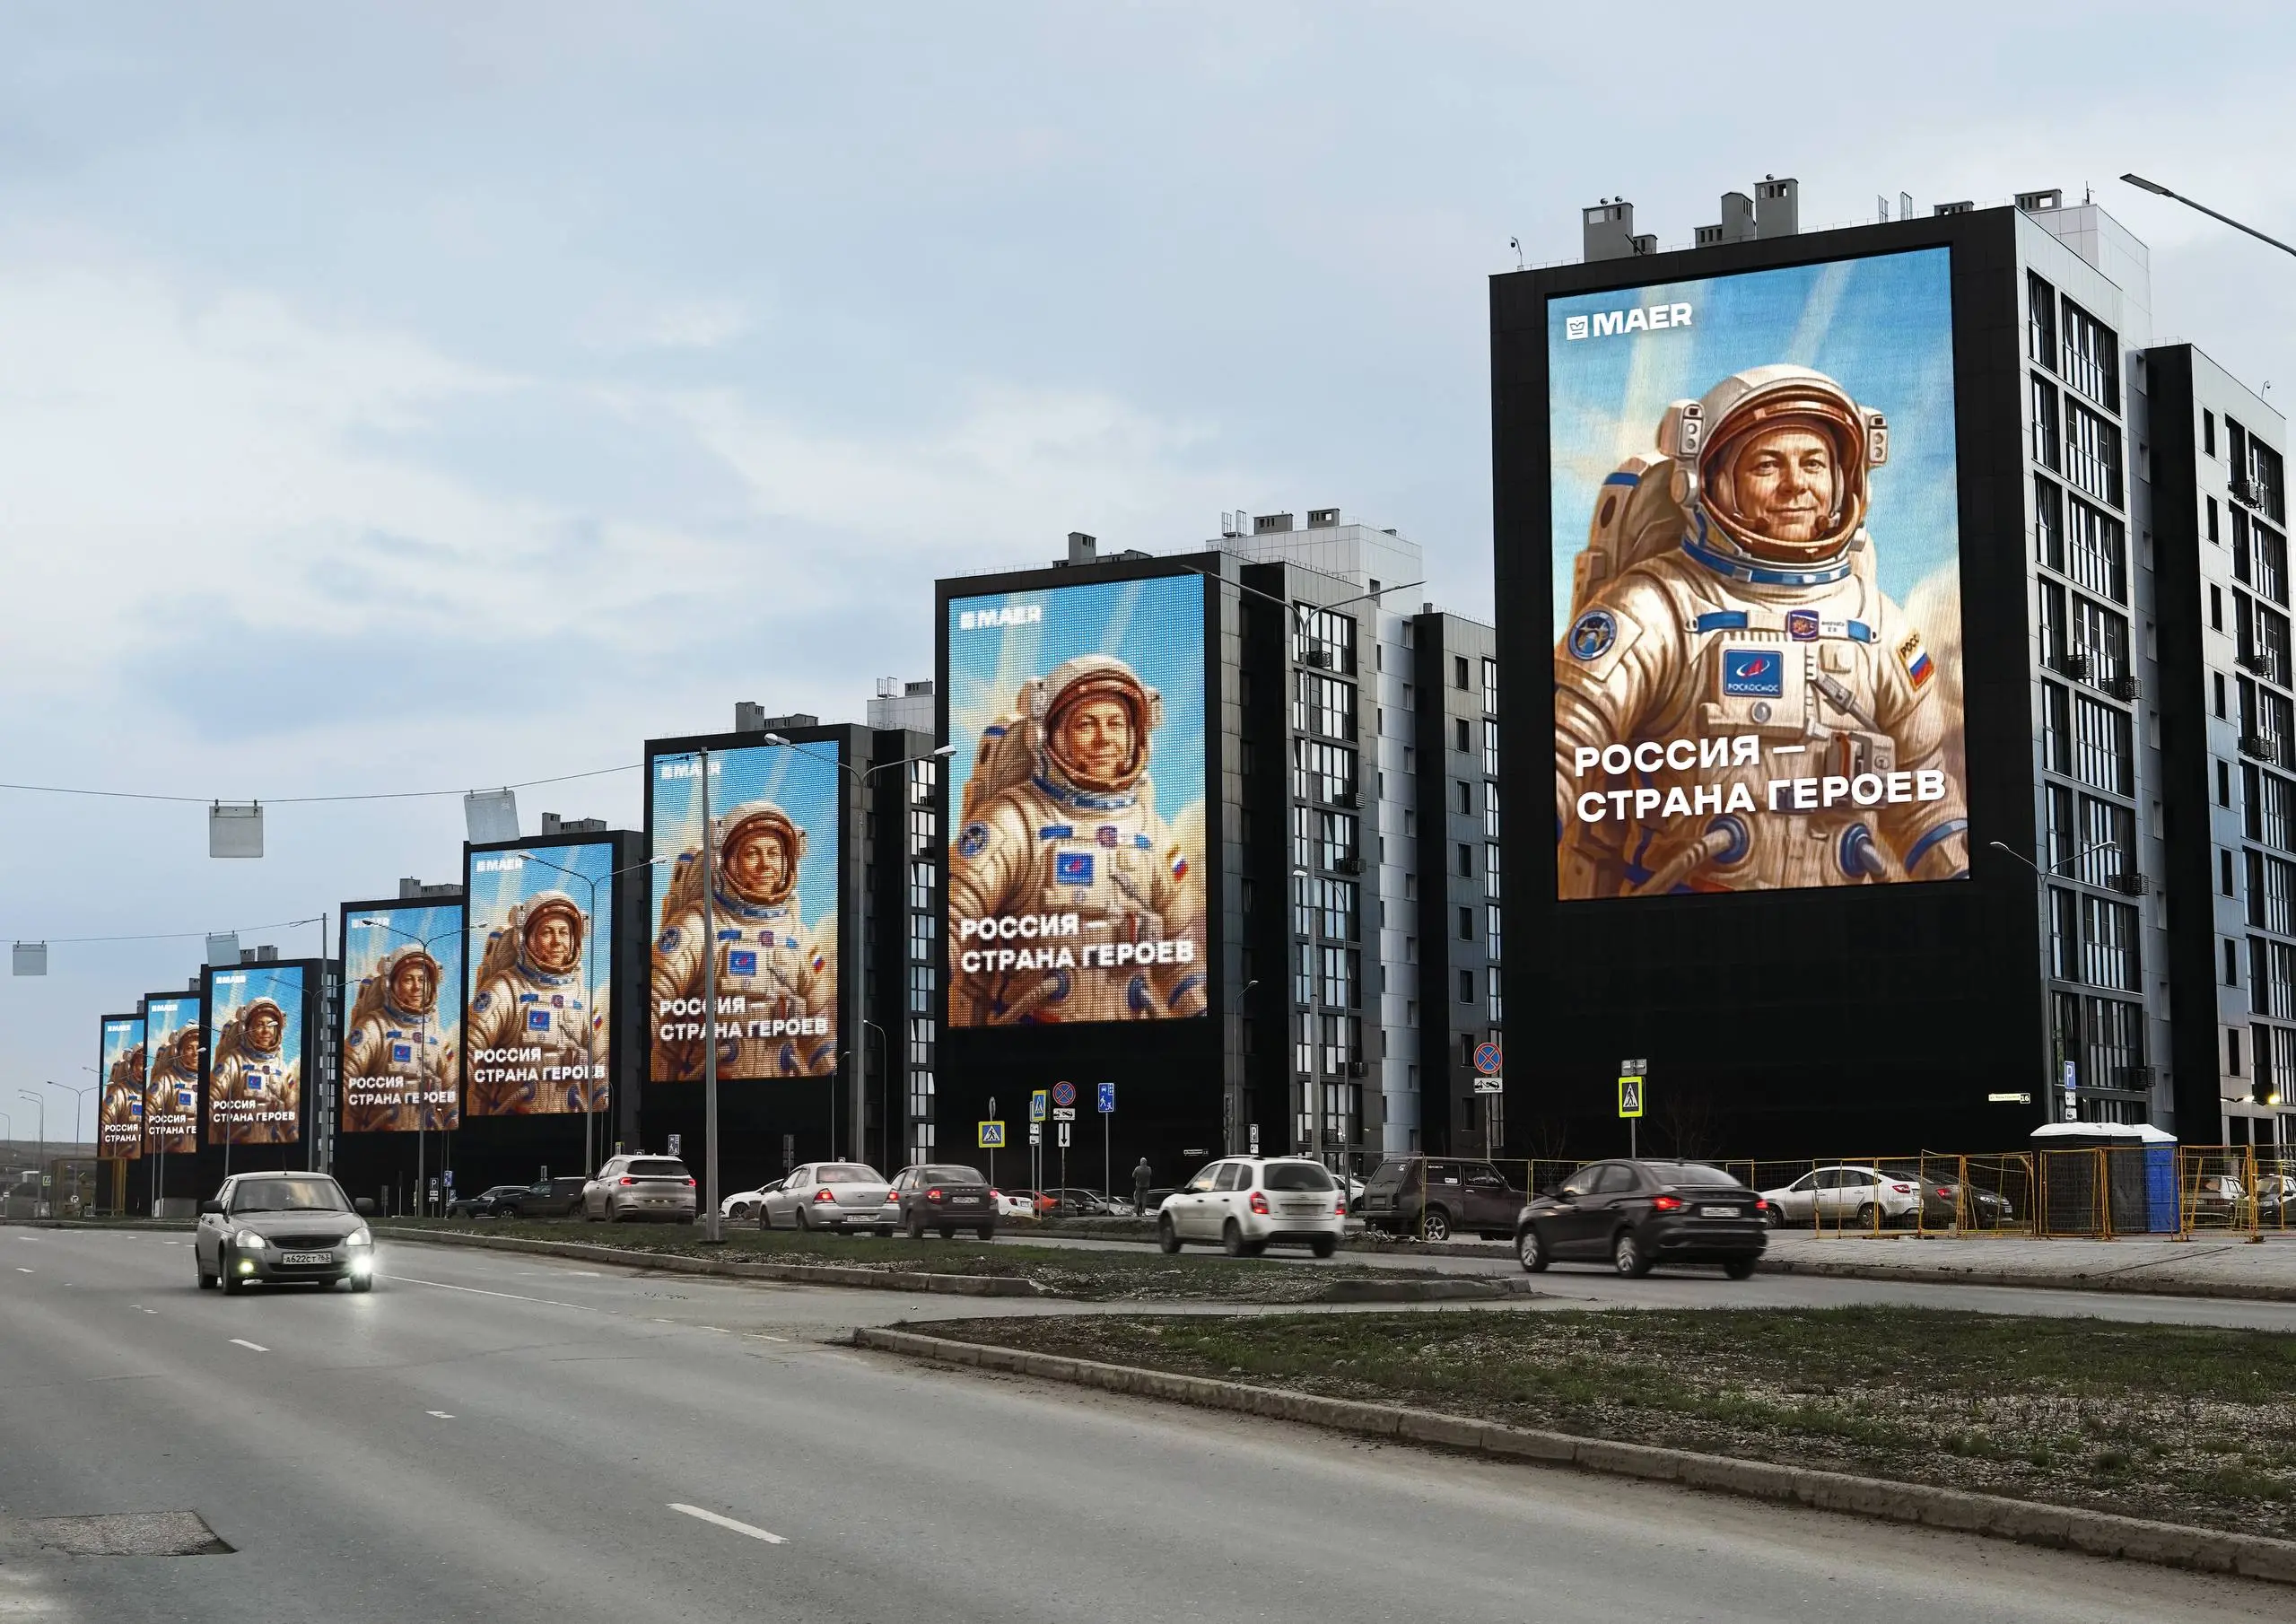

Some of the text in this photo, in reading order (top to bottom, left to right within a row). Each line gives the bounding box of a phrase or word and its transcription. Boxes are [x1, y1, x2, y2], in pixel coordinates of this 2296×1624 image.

[1593, 301, 1693, 337] MAER
[1575, 734, 1760, 777] РОССИЯ
[1576, 768, 1947, 823] СТРАНА ГЕРОЕВ
[959, 912, 1079, 941] РОССИЯ
[962, 940, 1194, 974] СТРАНА ГЕРОЕВ
[747, 1017, 829, 1037] ГЕРОЕВ
[474, 1046, 542, 1064] РОССИЯ
[474, 1068, 538, 1083] СТРАНА
[2066, 1064, 2073, 1086] P
[348, 1076, 404, 1089] РОССИЯ
[213, 1099, 256, 1110] РОССИЯ
[348, 1092, 401, 1105] СТРАНА
[148, 1113, 187, 1123] РОССИЯ
[213, 1111, 296, 1123] СТРАНА ГЕРОЕВ
[104, 1123, 139, 1132] РОССИЯ
[148, 1125, 185, 1135] СТРАНА
[104, 1133, 137, 1142] СТРАНА
[285, 1254, 317, 1263] А622СТ
